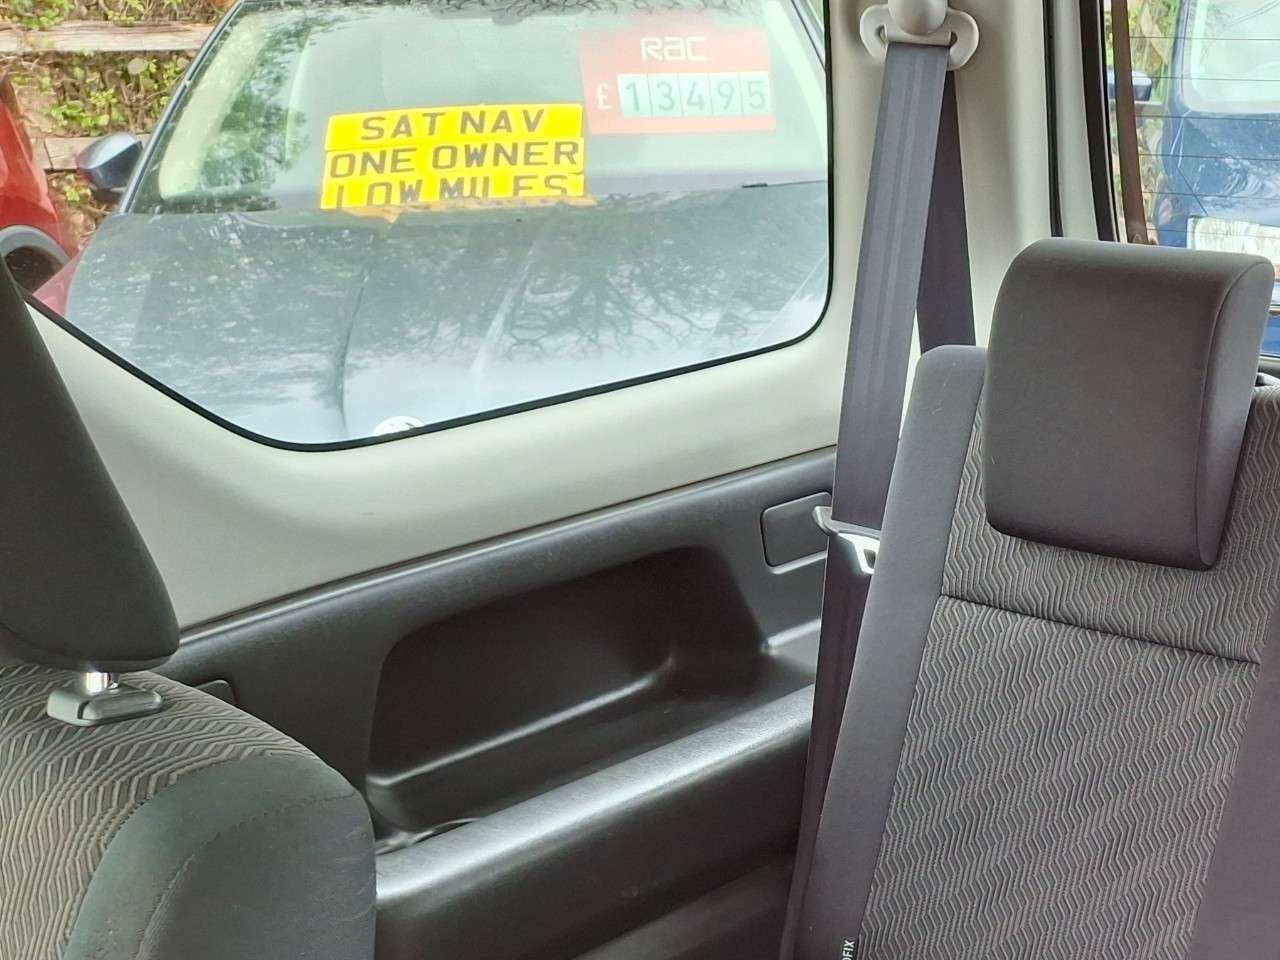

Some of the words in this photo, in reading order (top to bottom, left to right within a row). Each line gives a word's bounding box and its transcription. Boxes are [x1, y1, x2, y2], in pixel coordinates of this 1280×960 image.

[360, 112, 446, 140] SAT
[459, 108, 545, 135] NAV
[330, 147, 417, 179] ONE
[432, 141, 580, 170] OWNER
